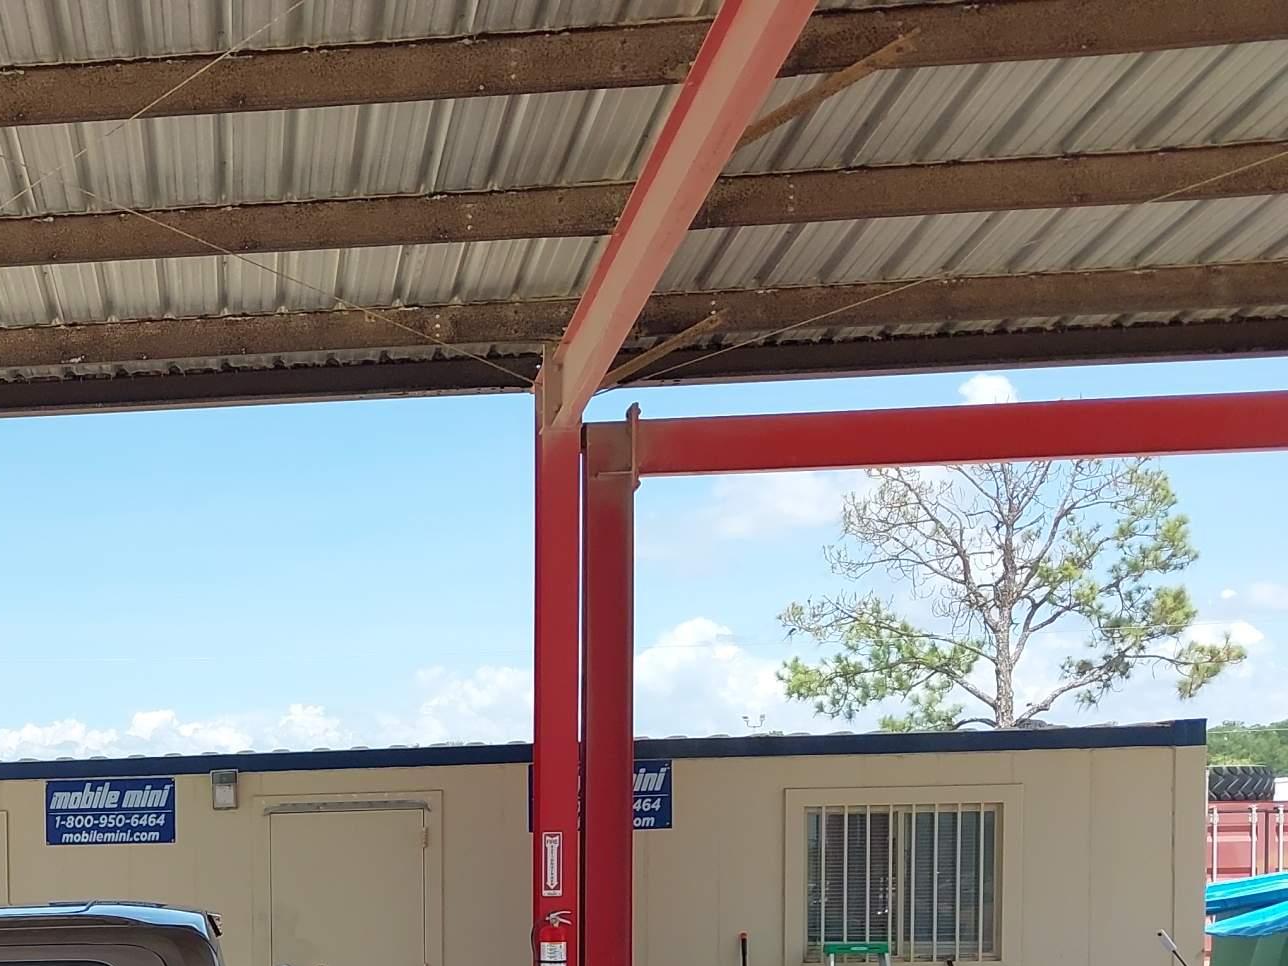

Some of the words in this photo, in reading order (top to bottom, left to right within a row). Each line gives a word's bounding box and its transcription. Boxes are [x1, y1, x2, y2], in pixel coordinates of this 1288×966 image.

[633, 767, 667, 792] ini
[50, 782, 120, 809] mobile
[122, 784, 170, 808] mini
[55, 813, 166, 828] 1-800-950-6464
[62, 830, 160, 843] mobilemini.com
